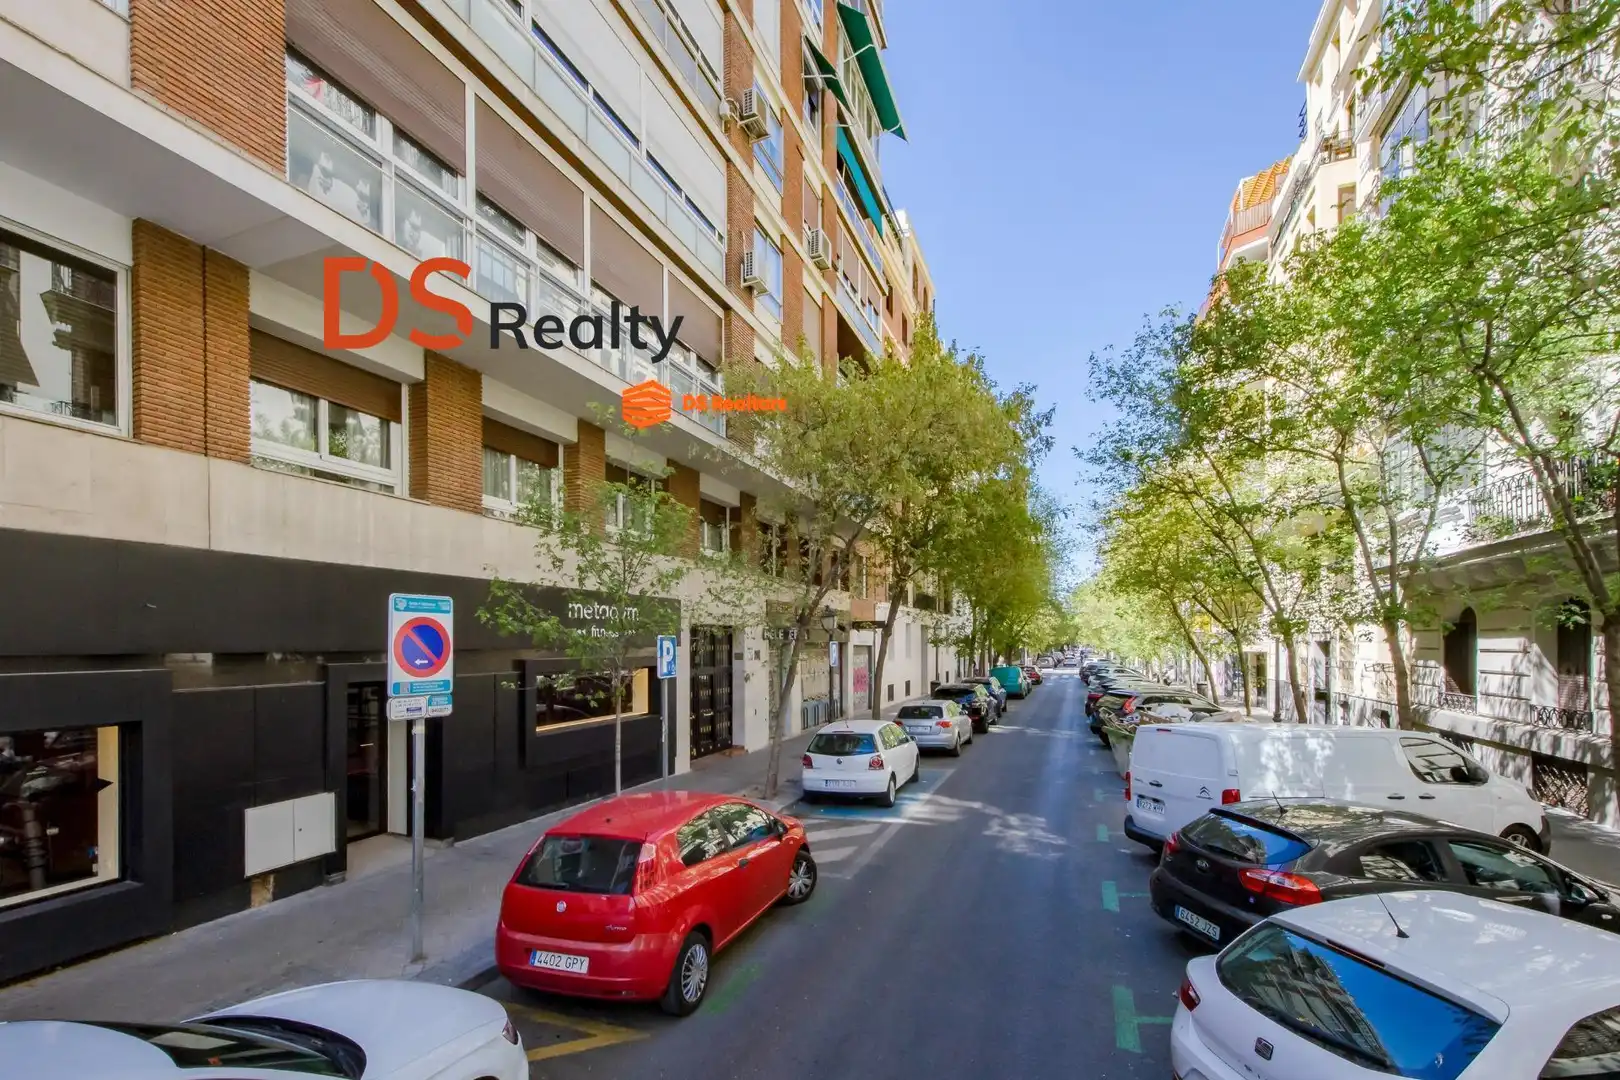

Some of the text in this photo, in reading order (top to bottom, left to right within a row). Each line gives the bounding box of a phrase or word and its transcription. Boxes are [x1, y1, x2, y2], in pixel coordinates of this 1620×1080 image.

[662, 640, 674, 673] P
[1180, 909, 1217, 937] 6452 JZS
[537, 952, 586, 971] 4402 GPY
